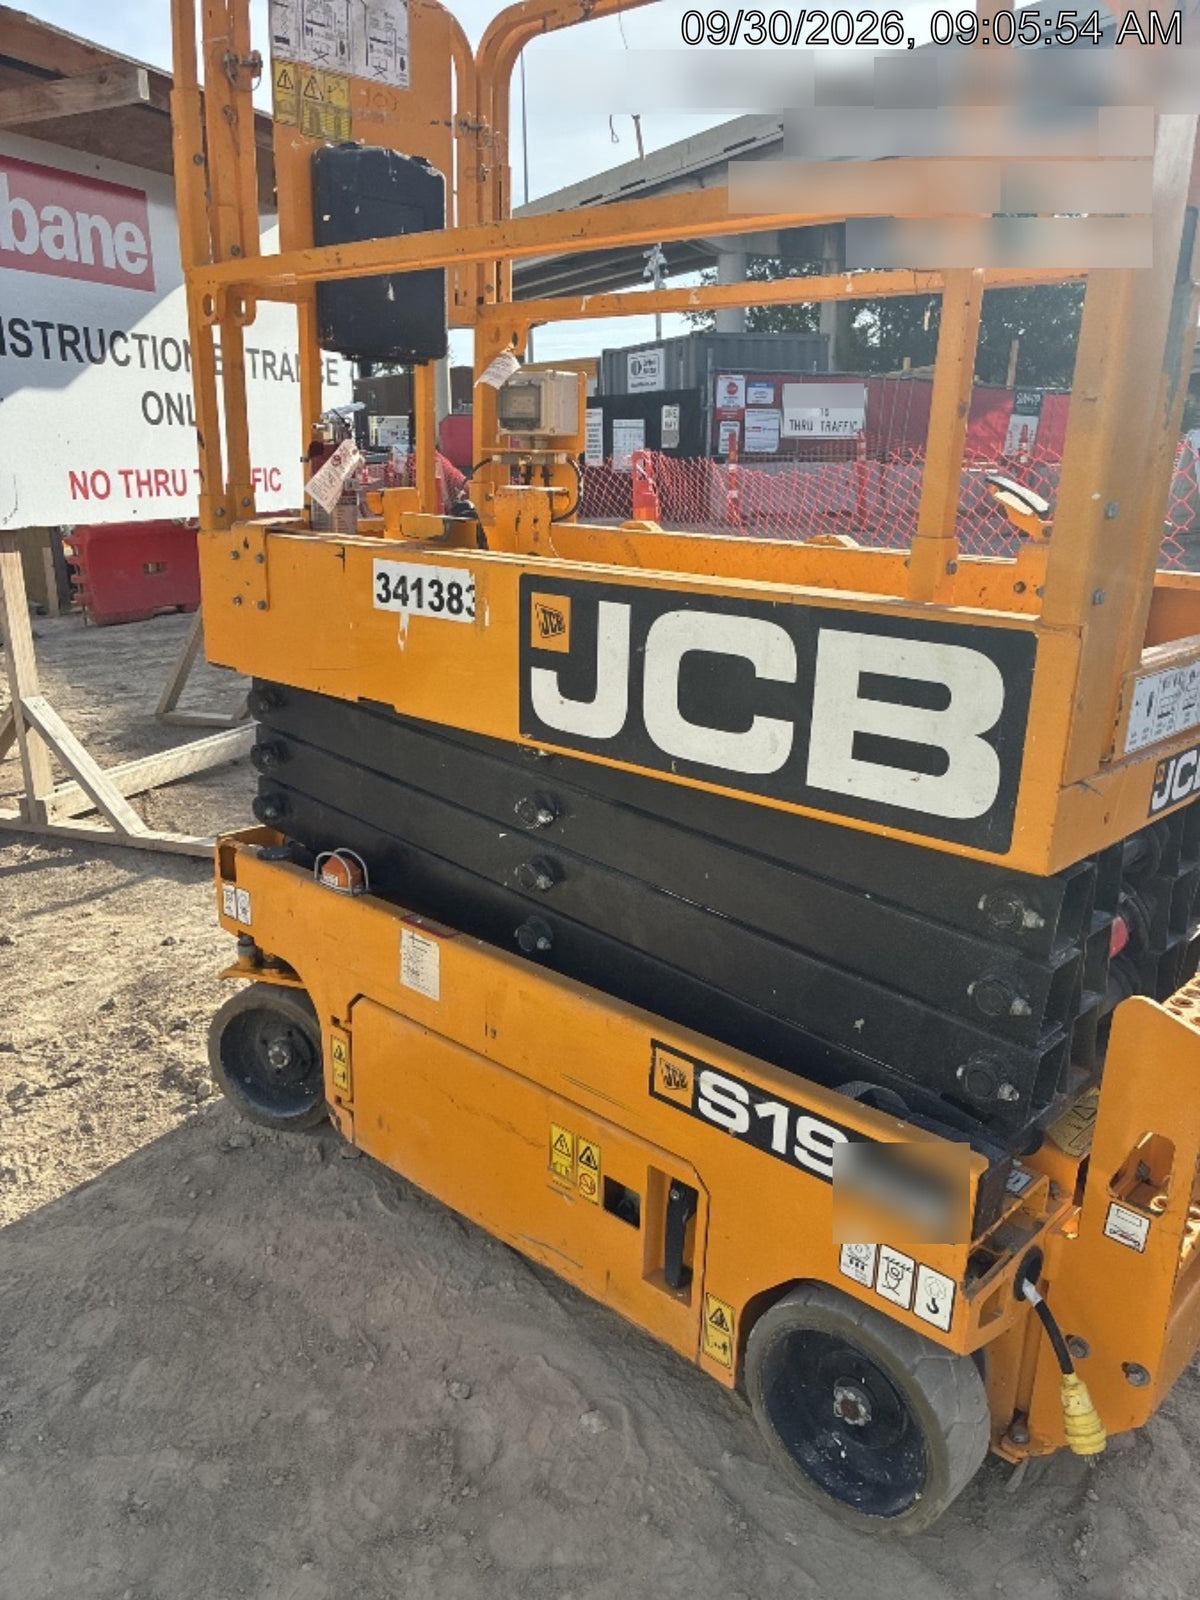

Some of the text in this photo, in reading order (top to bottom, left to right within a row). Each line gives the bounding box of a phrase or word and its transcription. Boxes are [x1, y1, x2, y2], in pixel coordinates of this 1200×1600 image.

[0, 316, 192, 372] STRUCTIO
[141, 390, 196, 426] ONL
[789, 419, 813, 431] THRU
[69, 469, 111, 500] NO
[118, 468, 188, 498] THRU
[531, 600, 1005, 819] JCB
[1152, 749, 1200, 811] JC
